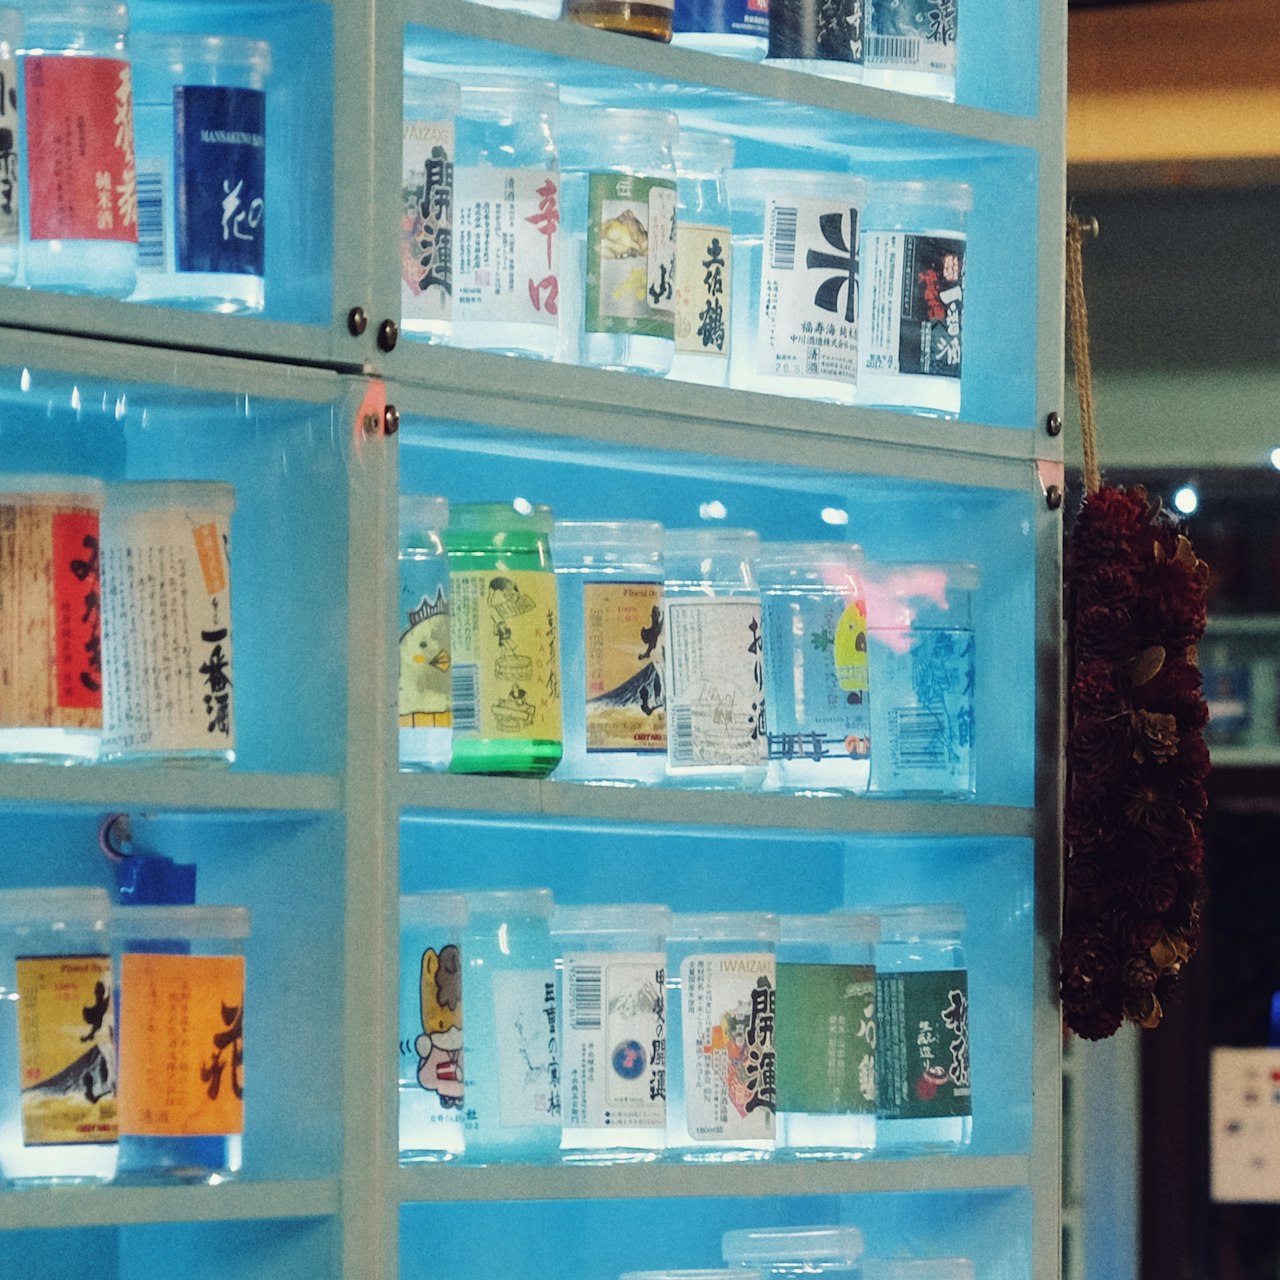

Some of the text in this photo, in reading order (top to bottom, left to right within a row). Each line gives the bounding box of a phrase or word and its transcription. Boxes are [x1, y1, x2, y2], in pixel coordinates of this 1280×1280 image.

[523, 178, 560, 315] 辛口
[697, 237, 726, 351] 土佐鶴
[720, 961, 773, 974] IWAIZAKE
[745, 974, 775, 1116] 開運
